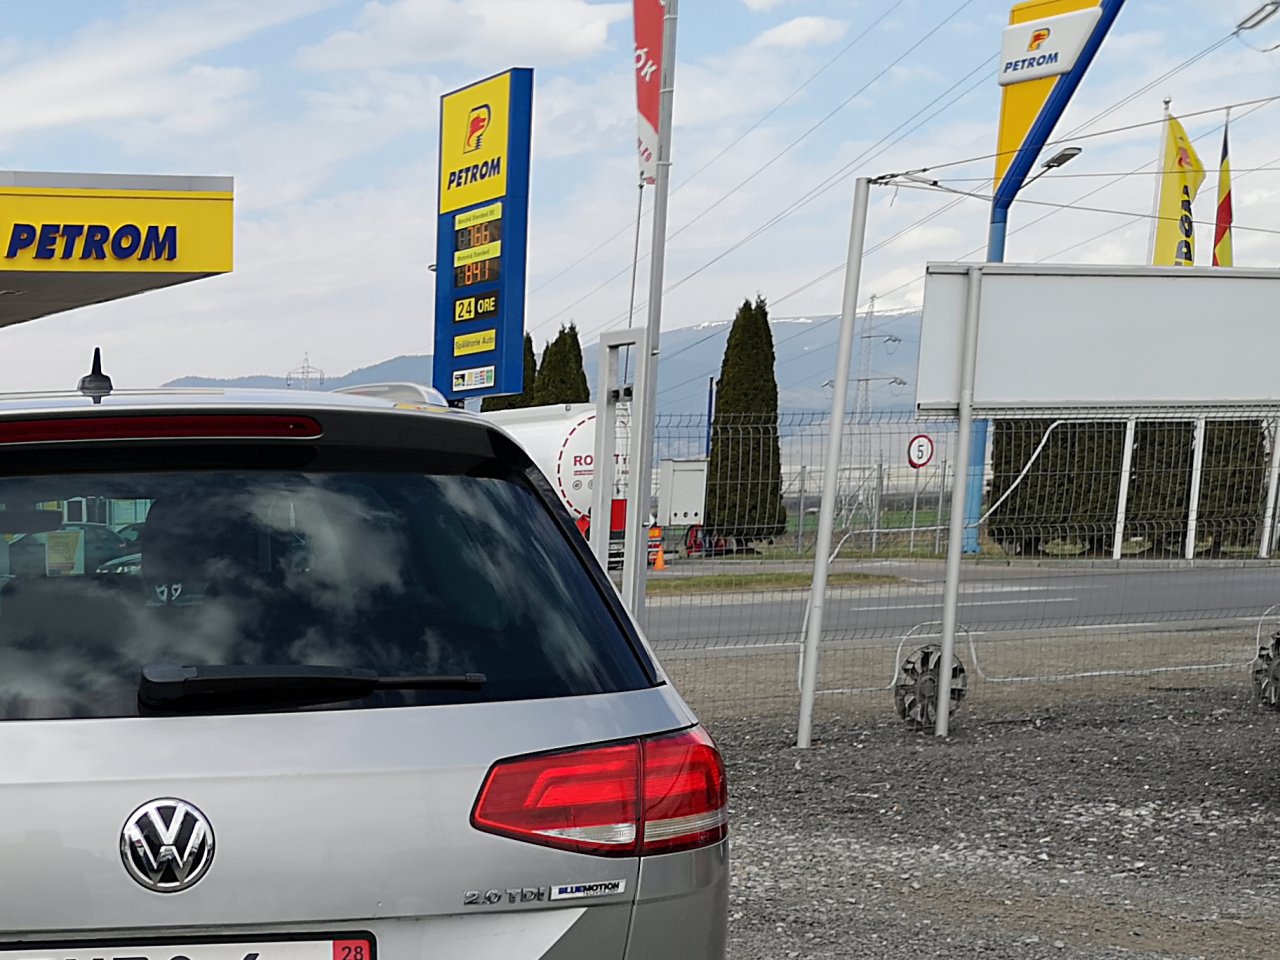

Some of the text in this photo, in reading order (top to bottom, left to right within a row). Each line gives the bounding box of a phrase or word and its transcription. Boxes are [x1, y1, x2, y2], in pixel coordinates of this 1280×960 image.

[1003, 52, 1059, 73] PETROM
[447, 156, 501, 190] PETROM
[5, 223, 178, 261] PETROM
[465, 260, 489, 285] 841
[458, 297, 496, 318] 24 ORE
[917, 444, 924, 459] 5
[464, 889, 501, 906] 2.0
[505, 887, 545, 903] TDI
[558, 881, 620, 895] BLUEMOTION
